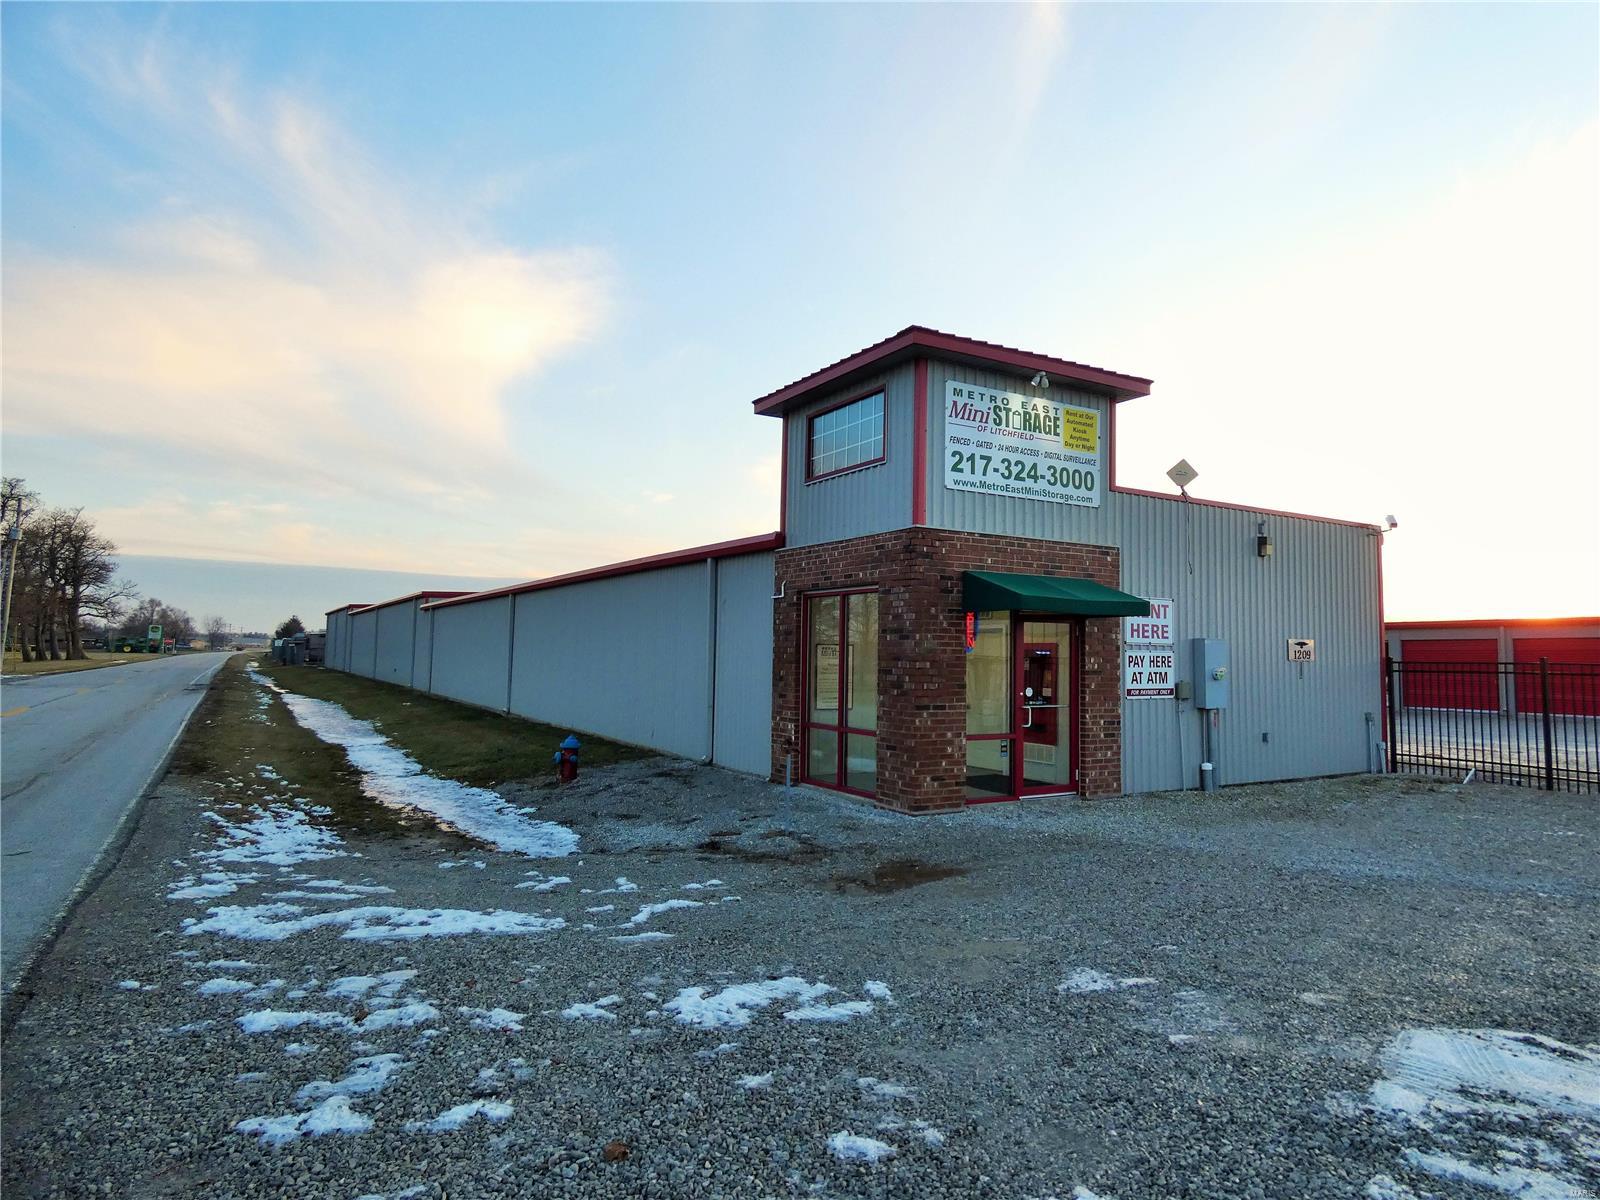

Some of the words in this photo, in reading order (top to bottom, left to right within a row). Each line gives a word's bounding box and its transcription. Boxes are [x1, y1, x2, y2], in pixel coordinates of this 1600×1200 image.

[953, 387, 1010, 406] METRO
[1021, 401, 1060, 416] EAST
[948, 400, 991, 424] Mini
[993, 405, 1061, 437] STORAGE
[1065, 410, 1077, 418] Rent
[1066, 418, 1094, 428] Automated
[977, 425, 988, 433] OF
[990, 427, 1035, 441] LITCHFIELD
[1069, 434, 1090, 442] Anytime
[949, 435, 971, 446] FENCED
[975, 440, 994, 450] GATED
[997, 443, 1005, 451] 24
[1005, 444, 1020, 454] HOUR
[1020, 446, 1040, 458] ACCESS
[1044, 451, 1062, 461] DIGITAL
[1063, 454, 1097, 467] SURVEILLANCE
[1064, 440, 1074, 449] Day
[1082, 443, 1095, 452] Night
[950, 450, 1095, 492] 217-324-3000
[953, 477, 1094, 504] www.MetroEastMiniStorage.com
[1130, 623, 1169, 640] HERE
[1128, 655, 1145, 668] PAY
[1149, 655, 1172, 668] HERE
[1293, 649, 1312, 660] 1209
[1131, 672, 1144, 685] AT
[1146, 671, 1168, 685] ATM
